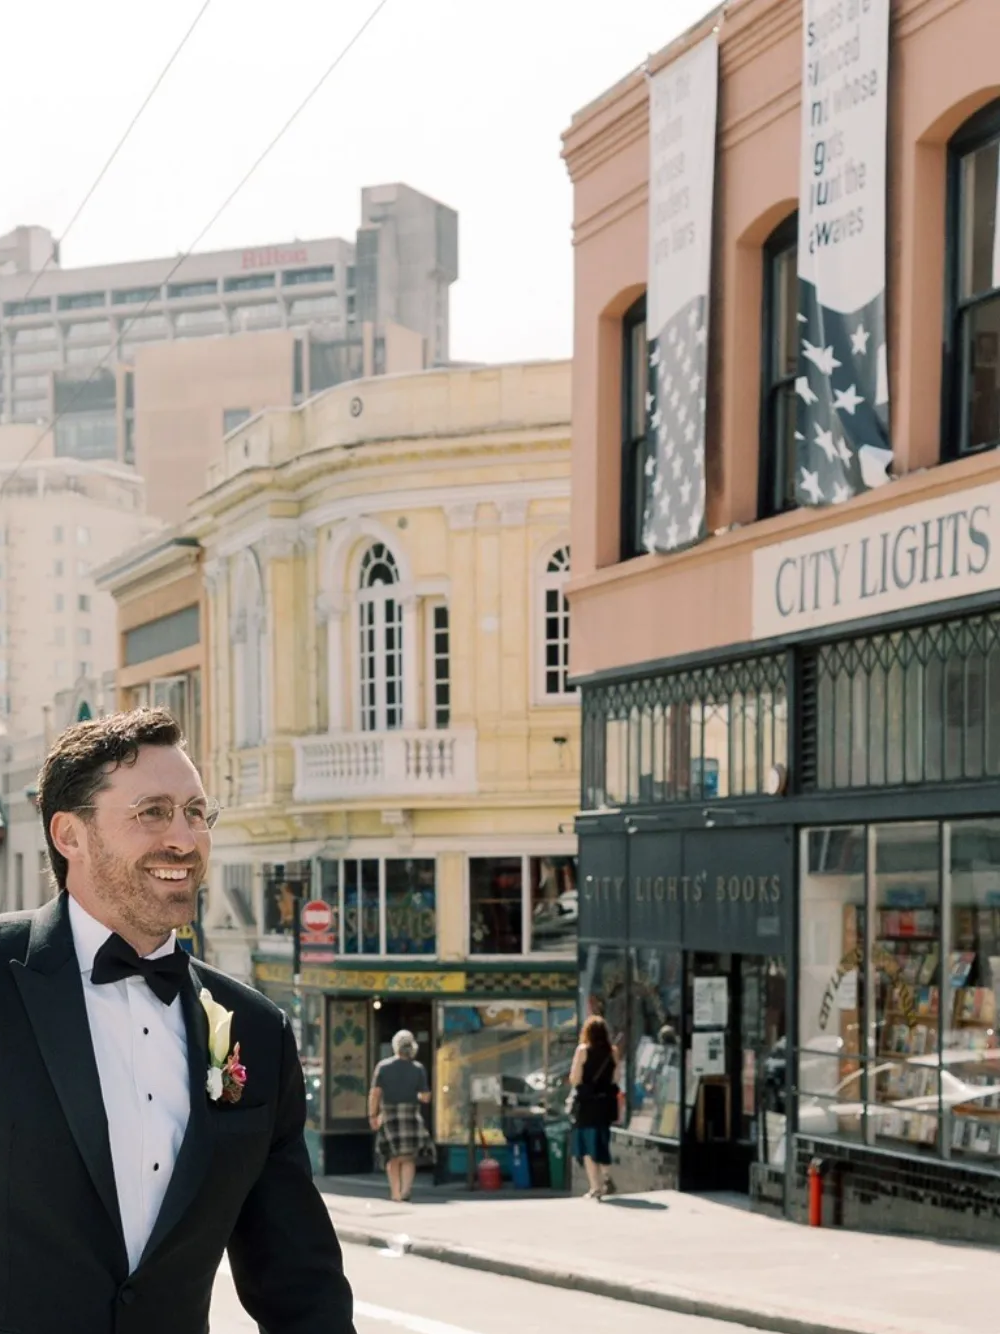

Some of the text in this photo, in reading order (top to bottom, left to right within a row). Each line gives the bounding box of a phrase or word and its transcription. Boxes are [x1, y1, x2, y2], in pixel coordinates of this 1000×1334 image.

[242, 247, 307, 269] Hilton
[775, 505, 990, 617] CITY LIGHTS
[584, 874, 625, 903] CITY
[716, 874, 781, 903] BOOKS
